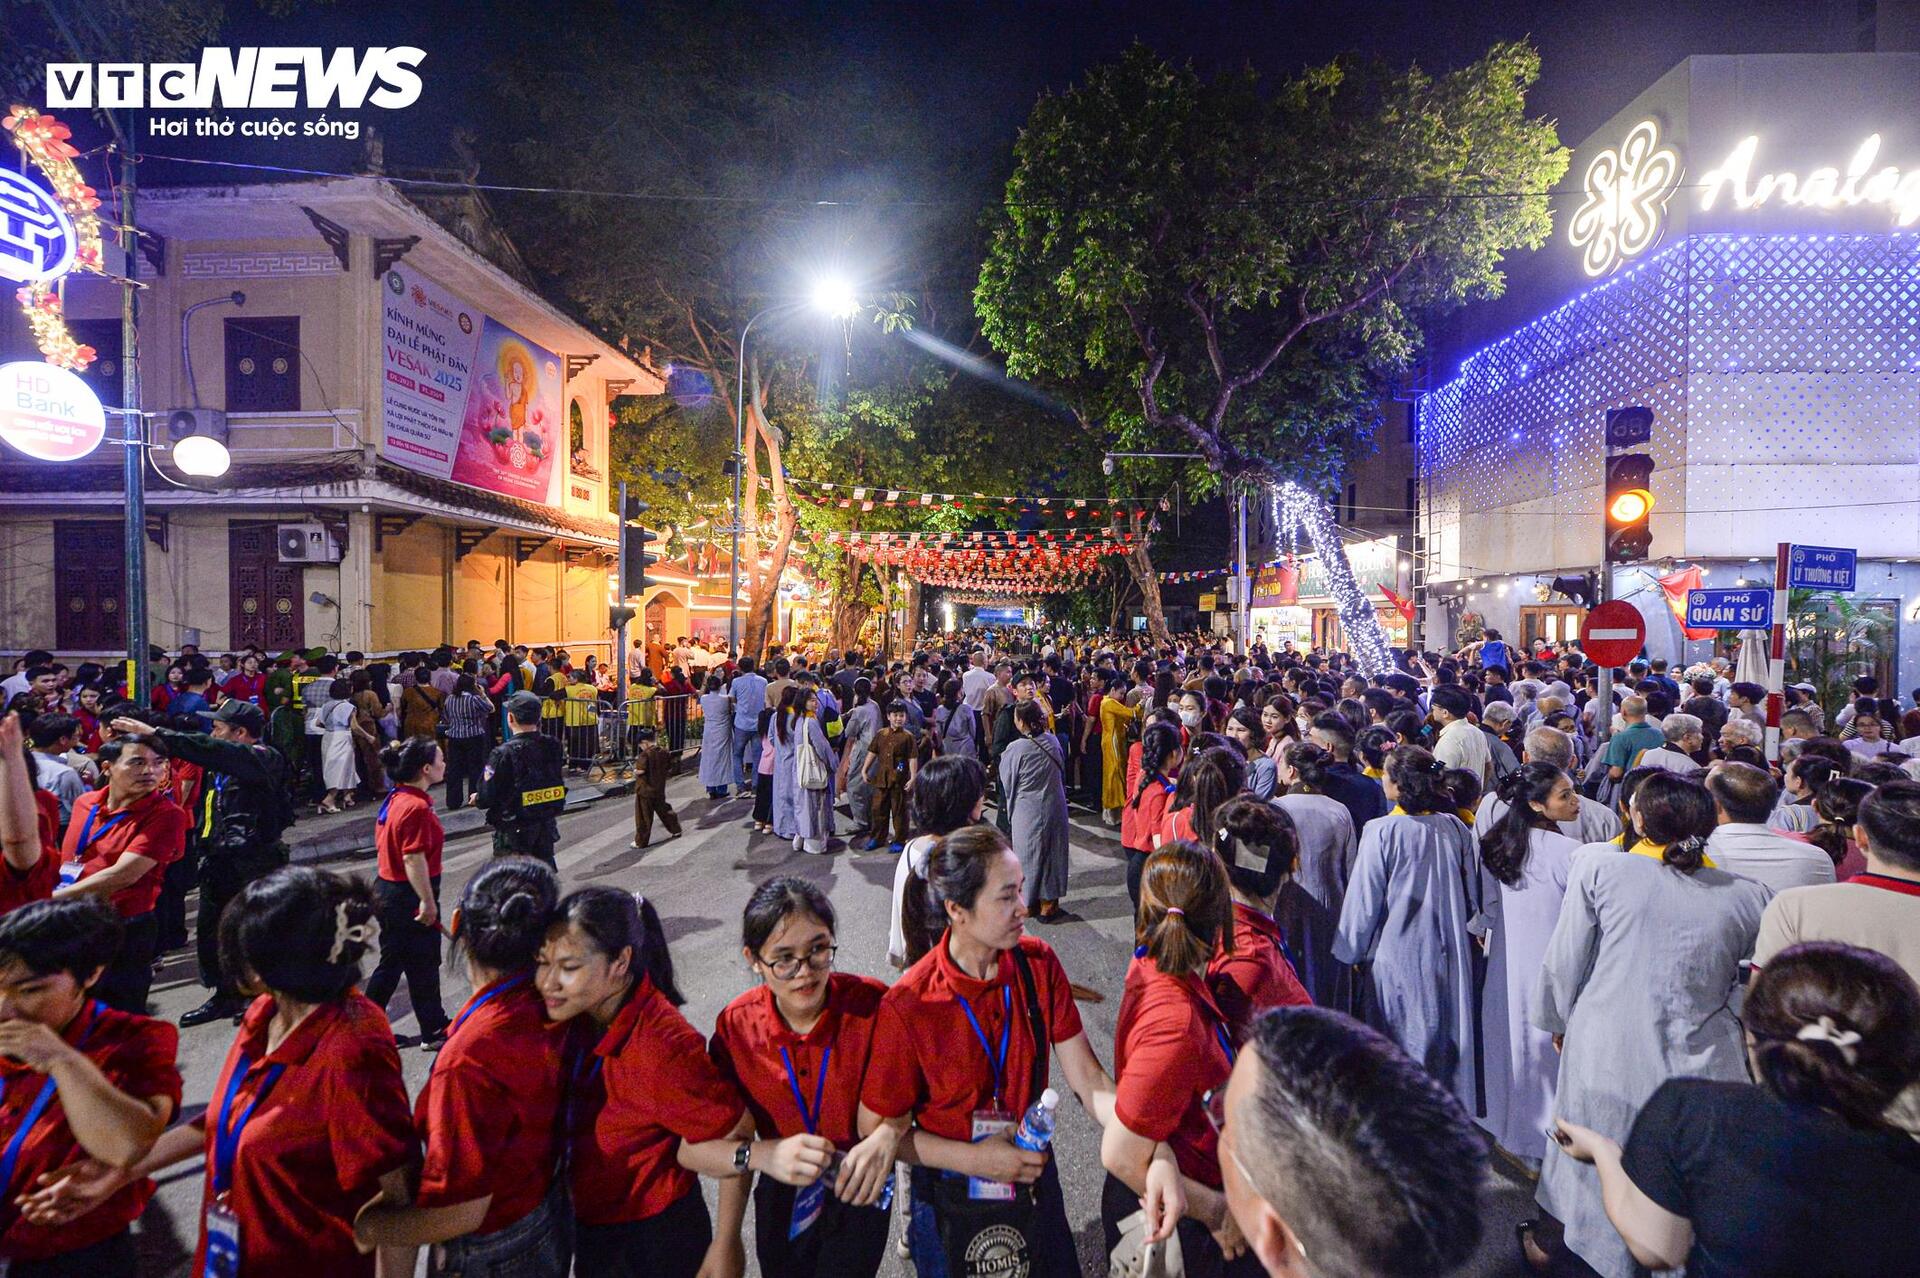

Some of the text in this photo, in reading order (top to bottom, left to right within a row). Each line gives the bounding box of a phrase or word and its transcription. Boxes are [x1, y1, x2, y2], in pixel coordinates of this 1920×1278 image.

[387, 307, 413, 329] KÍNH
[387, 327, 405, 344] ĐẠI
[422, 343, 445, 363] PHẬT
[387, 345, 462, 392] VESAK 2025
[16, 372, 50, 394] HD
[16, 391, 75, 417] Bank
[1815, 551, 1836, 562] PHỐ
[1794, 566, 1850, 586] LÝ THƯỜNG KIỆT
[1723, 592, 1751, 603] PHỐ
[1692, 604, 1765, 622] QUÁN SỨ
